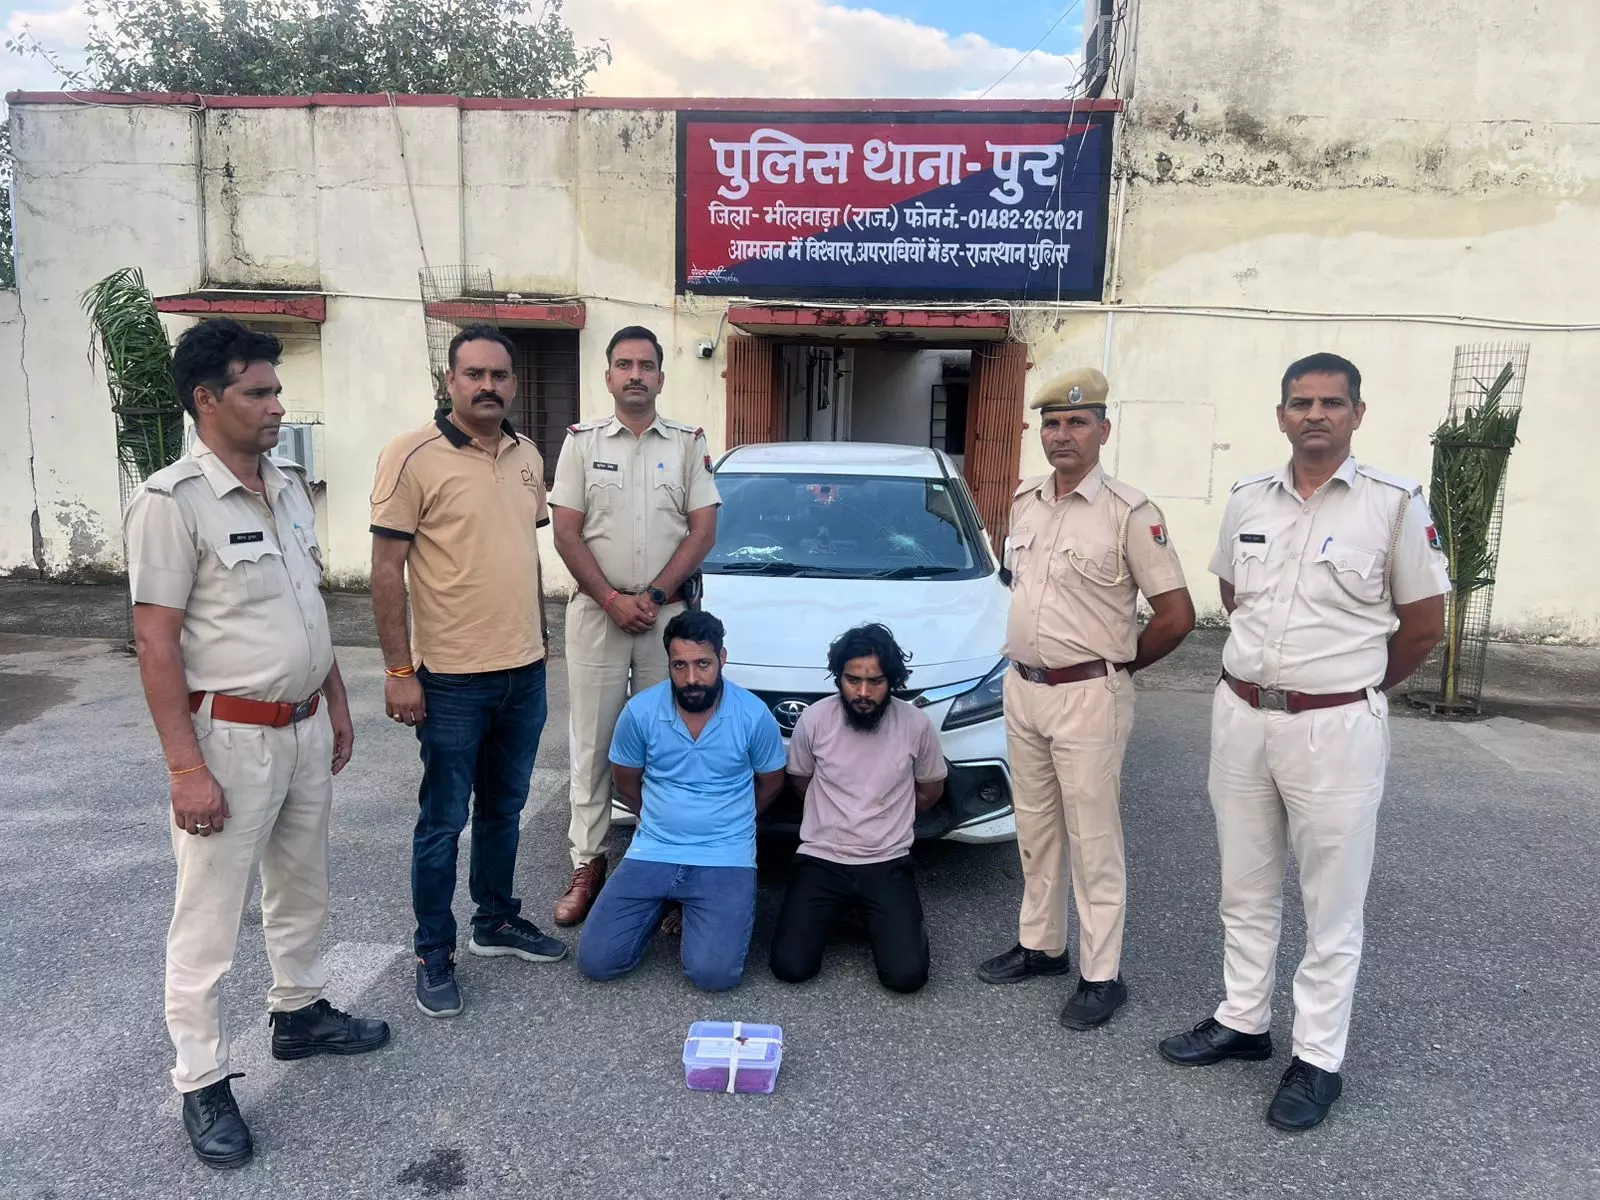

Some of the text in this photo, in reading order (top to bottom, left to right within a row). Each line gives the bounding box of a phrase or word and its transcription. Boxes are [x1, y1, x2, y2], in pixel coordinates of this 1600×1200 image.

[709, 128, 854, 200] पुलिस
[985, 140, 1064, 205] पुर
[763, 200, 841, 232] भीलवाड़ा
[843, 204, 898, 232] (राज.)
[728, 239, 785, 261] आमजन
[788, 236, 804, 261] में
[1028, 239, 1070, 271] पुलिस
